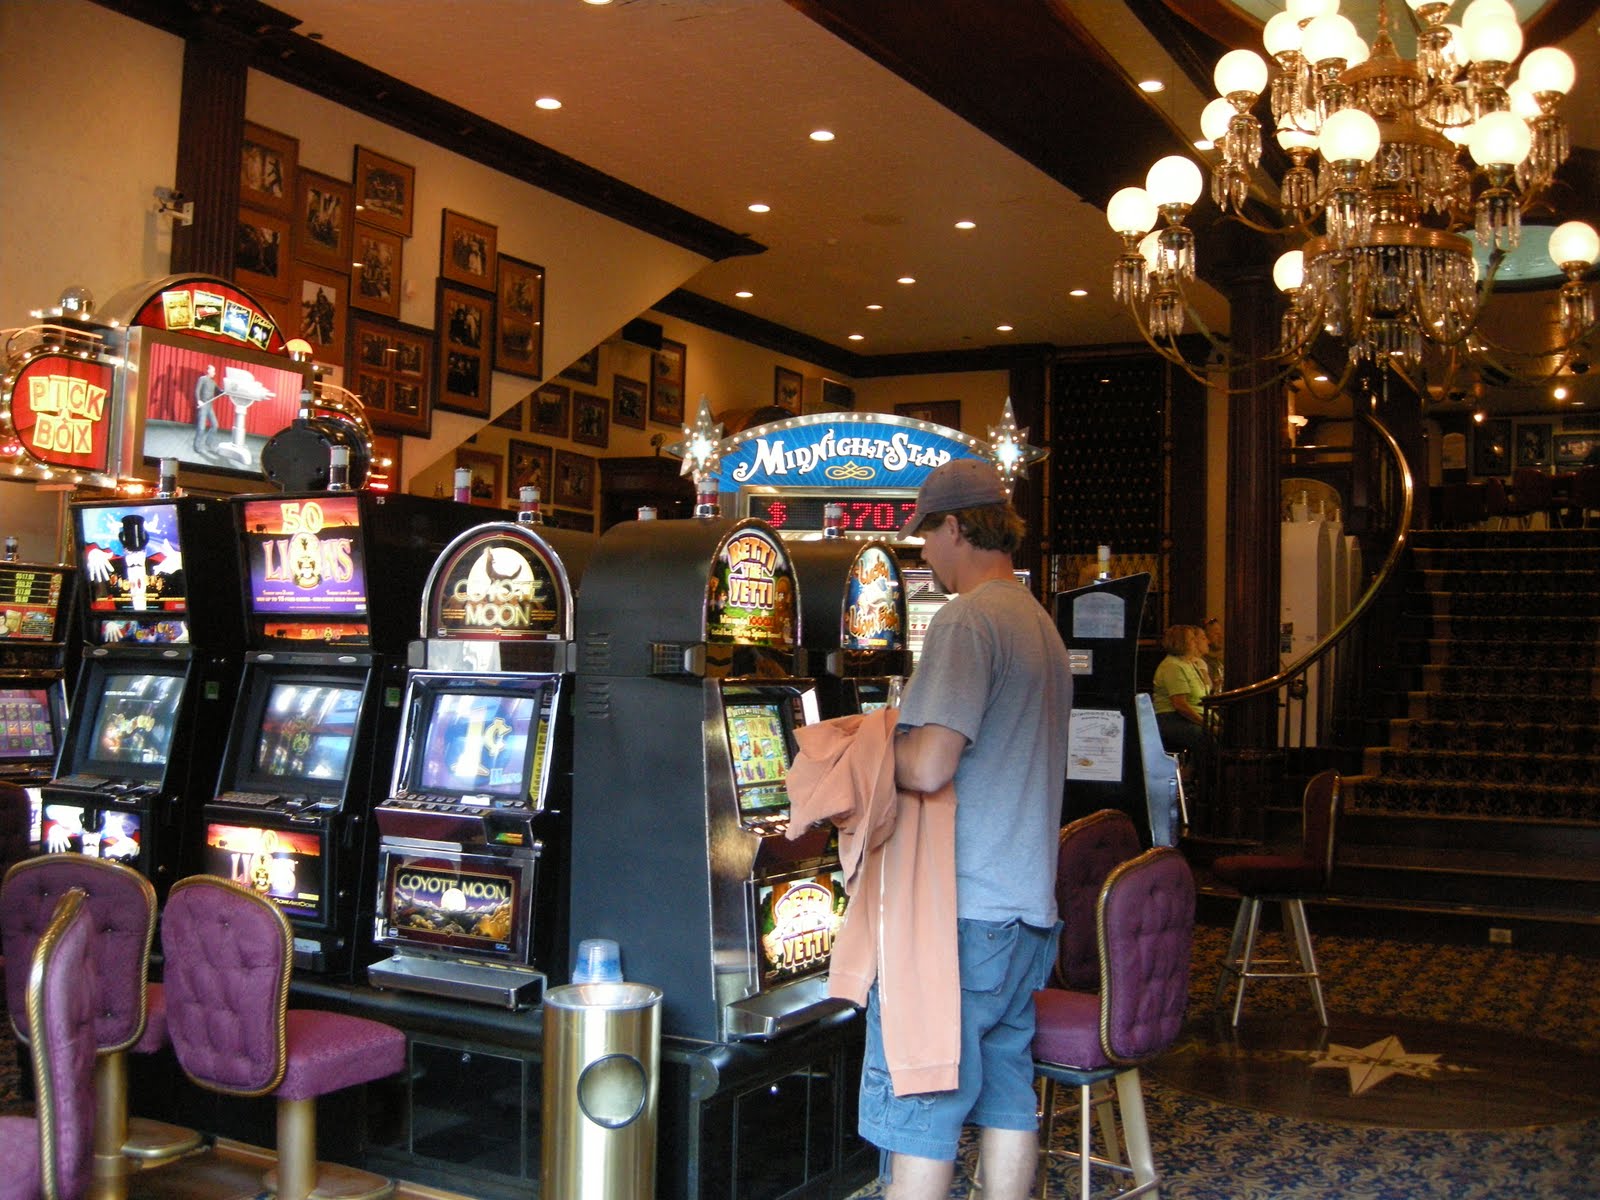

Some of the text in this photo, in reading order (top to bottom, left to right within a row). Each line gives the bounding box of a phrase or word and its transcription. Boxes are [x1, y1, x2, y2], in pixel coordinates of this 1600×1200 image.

[31, 379, 104, 419] PICK
[35, 417, 91, 452] BOX
[376, 496, 385, 504] 75
[280, 502, 324, 534] 50
[262, 533, 354, 587] LIONS
[728, 536, 777, 573] BETTI
[454, 579, 545, 603] COYOTE
[730, 578, 774, 607] YETTI
[465, 603, 531, 627] MOON
[399, 874, 508, 899] COYOTE MOON
[782, 928, 832, 967] YETTI
